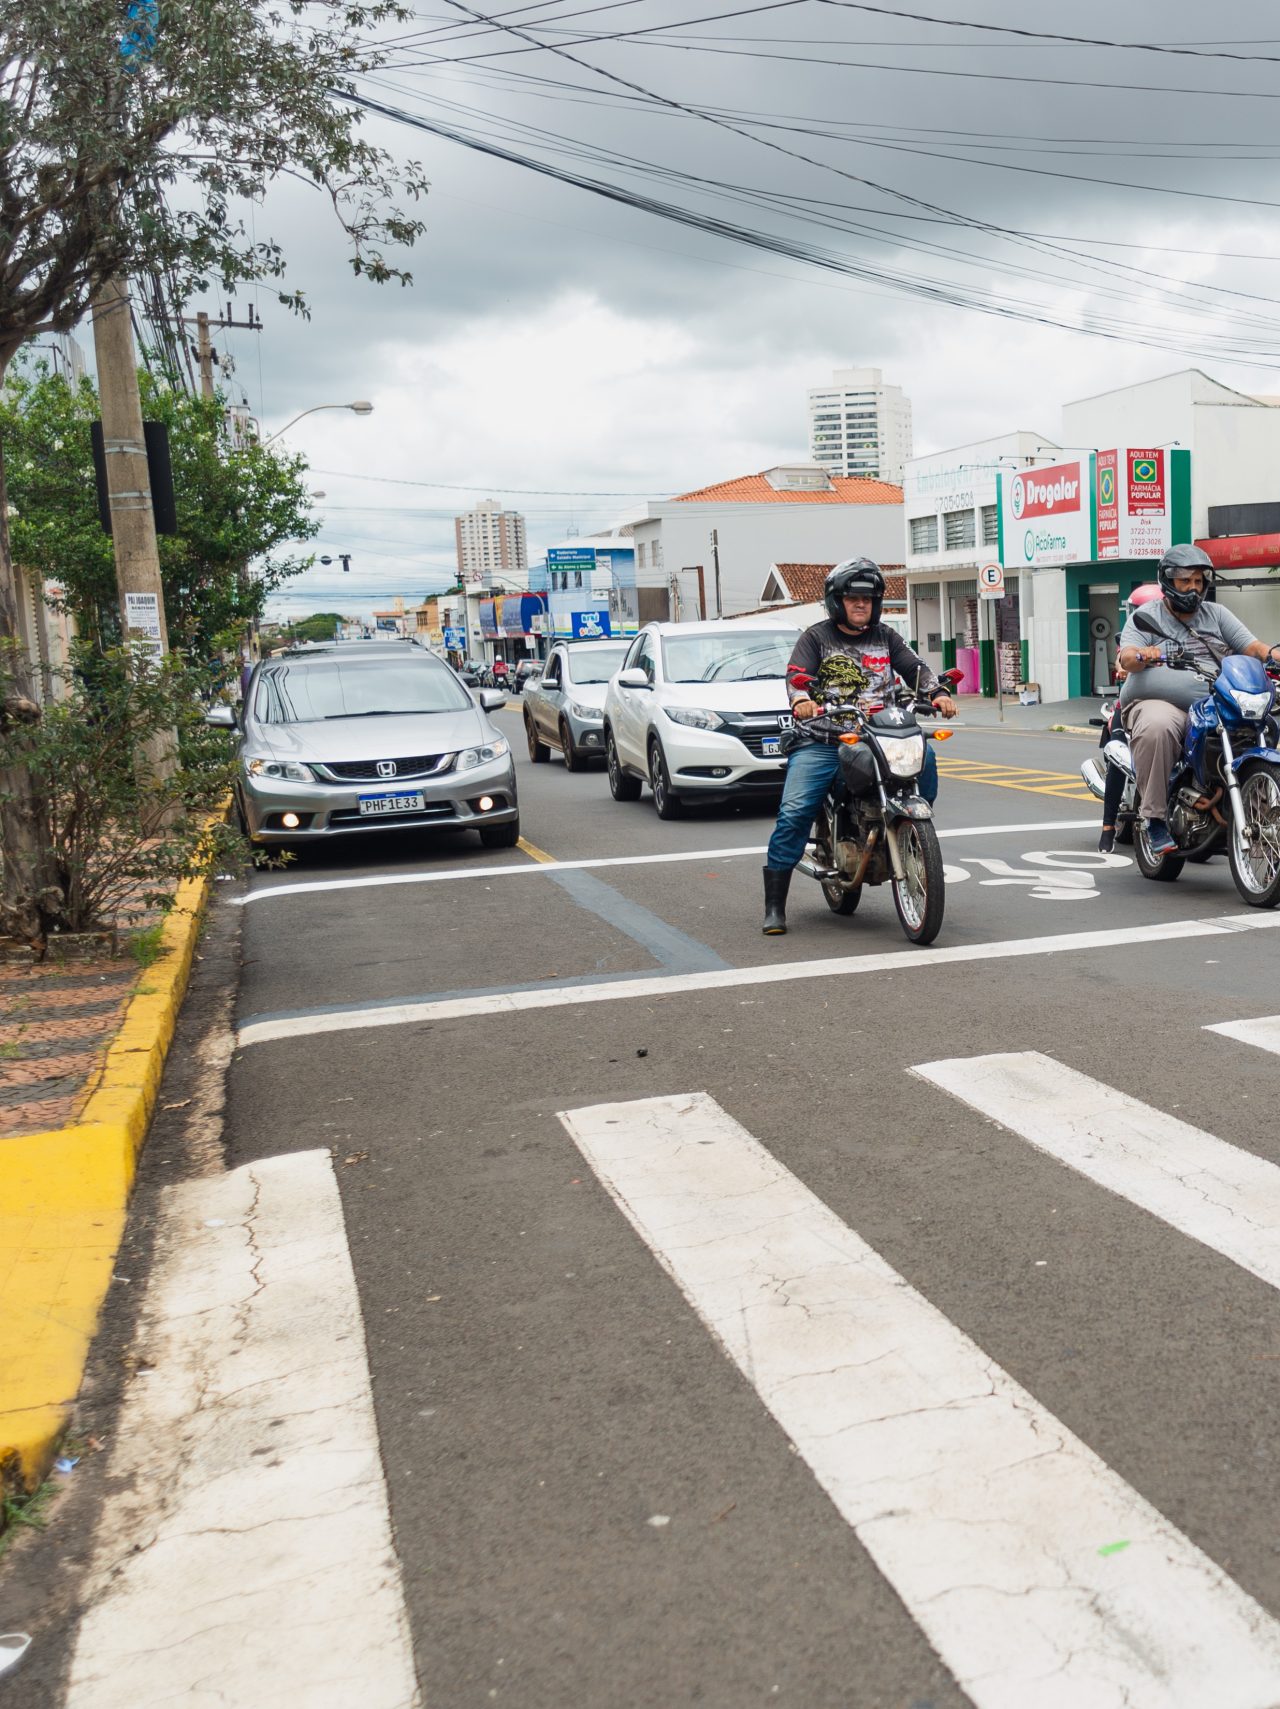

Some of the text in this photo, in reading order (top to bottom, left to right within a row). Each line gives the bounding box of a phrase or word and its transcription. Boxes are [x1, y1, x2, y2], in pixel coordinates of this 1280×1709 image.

[1027, 476, 1078, 509] Drogalar
[988, 570, 996, 582] E
[365, 797, 418, 811] PHF1E33
